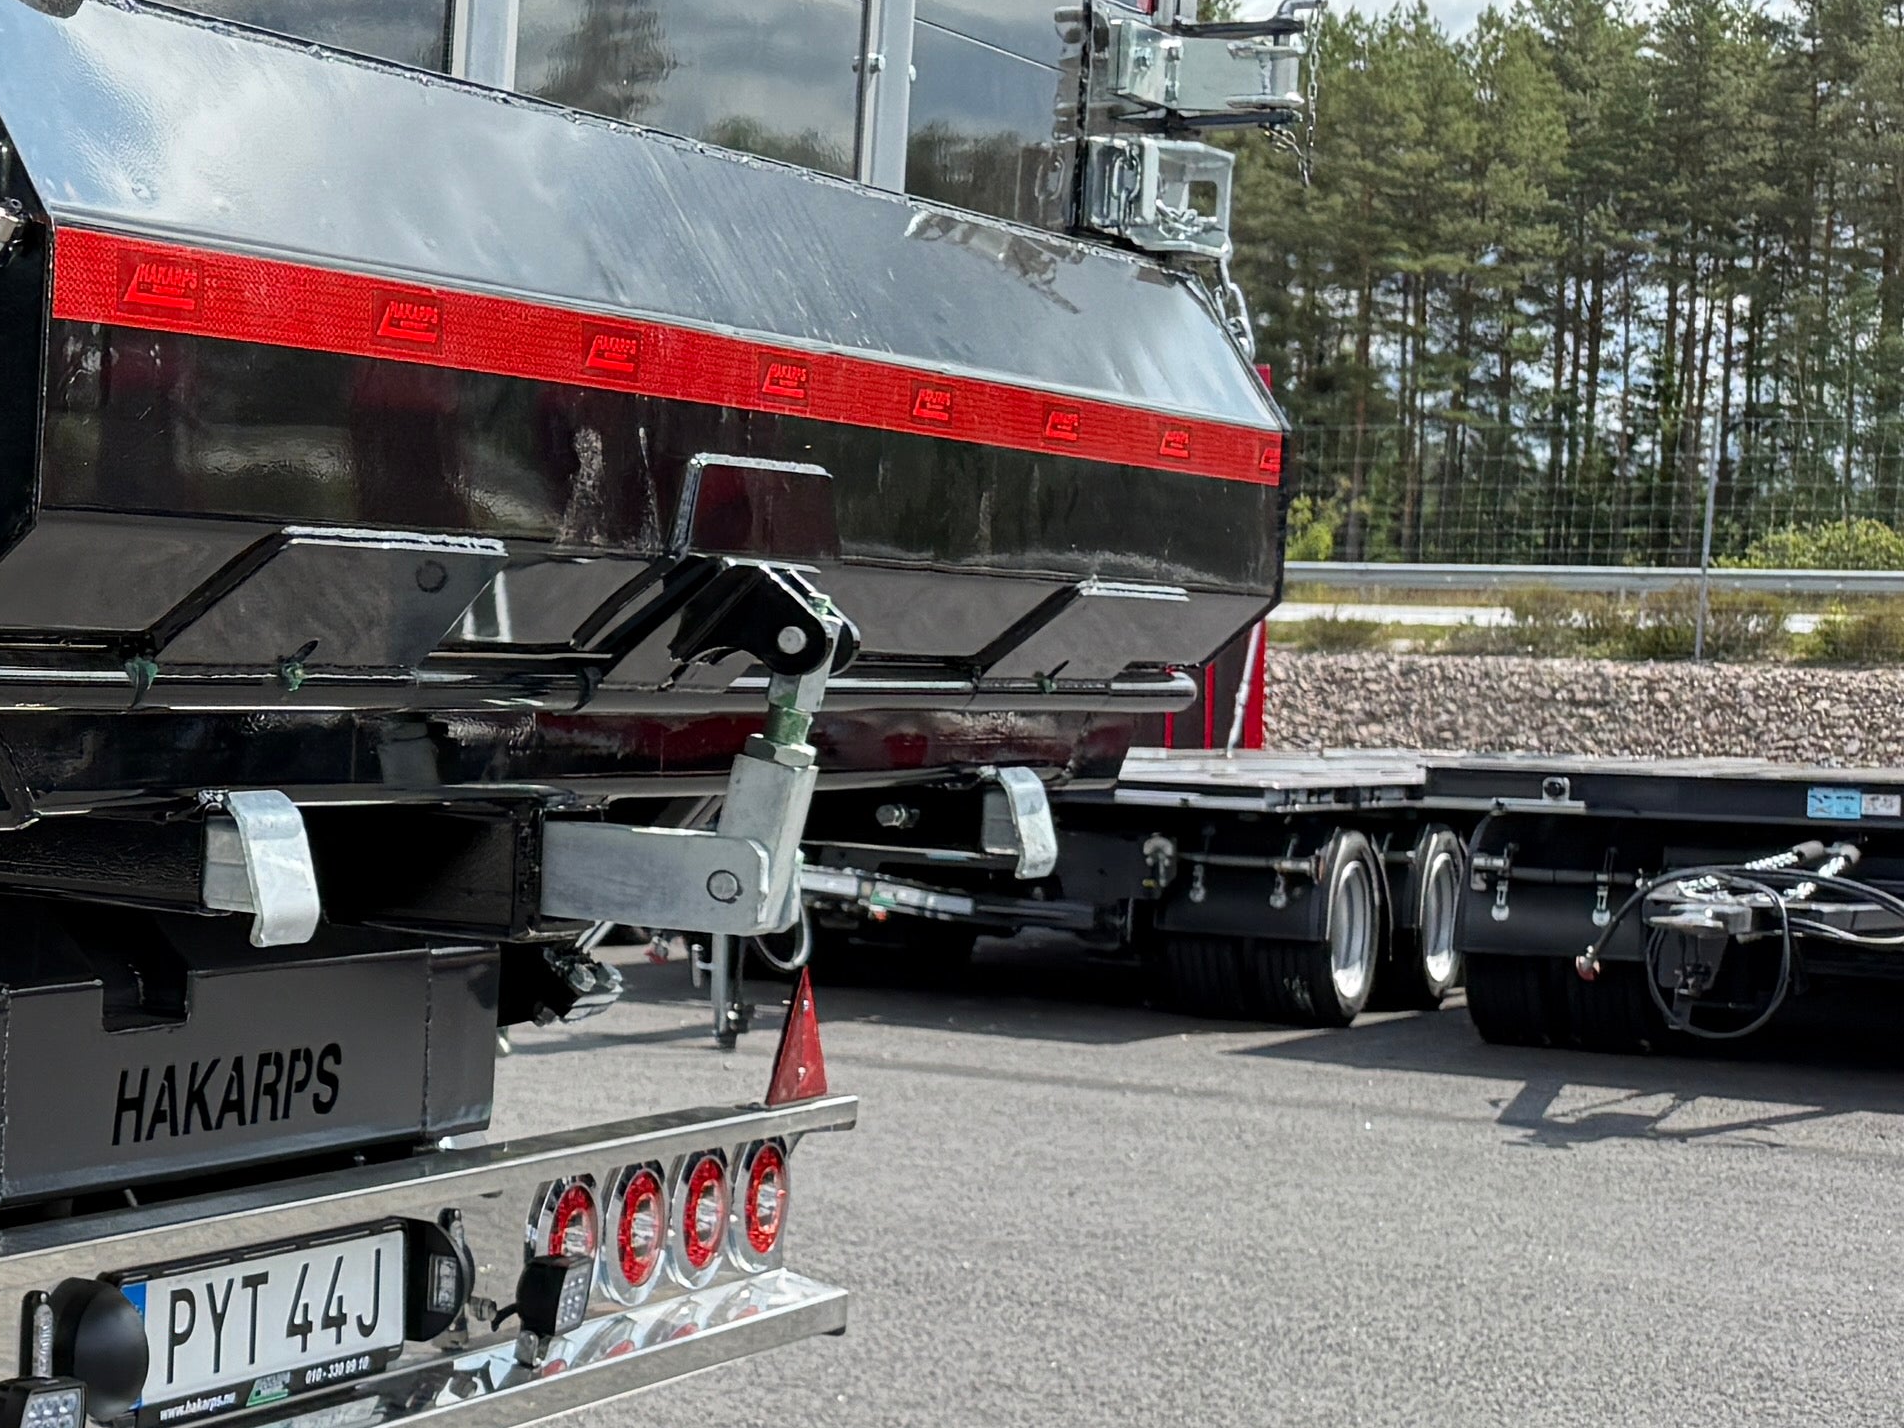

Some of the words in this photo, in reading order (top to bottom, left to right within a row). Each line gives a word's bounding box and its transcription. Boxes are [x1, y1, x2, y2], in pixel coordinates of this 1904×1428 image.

[111, 1042, 343, 1147] HAKARPS
[166, 1270, 270, 1385] PYT
[286, 1247, 382, 1353] 44J
